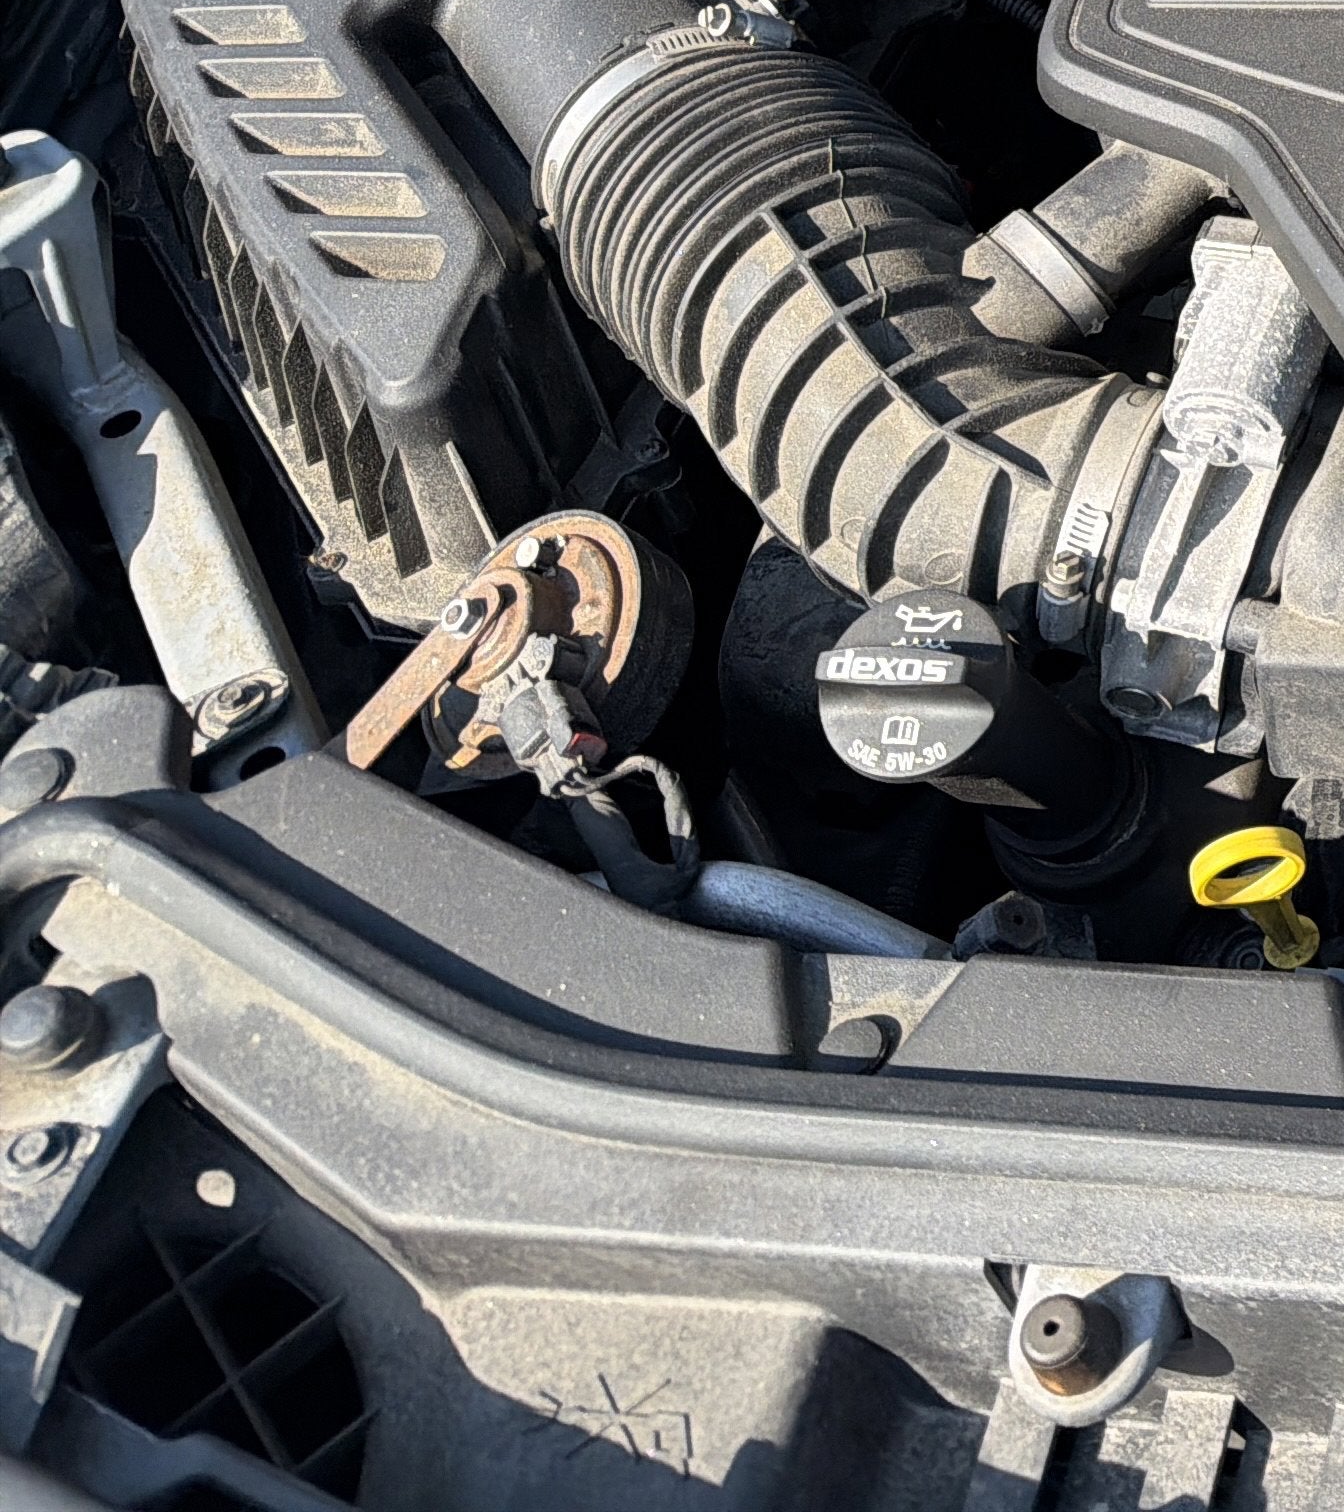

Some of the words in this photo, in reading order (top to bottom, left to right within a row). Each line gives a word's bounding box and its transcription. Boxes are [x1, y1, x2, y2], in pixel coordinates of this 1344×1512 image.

[826, 648, 952, 682] dexos
[847, 738, 881, 768] SAE
[885, 741, 947, 772] 5W-30
